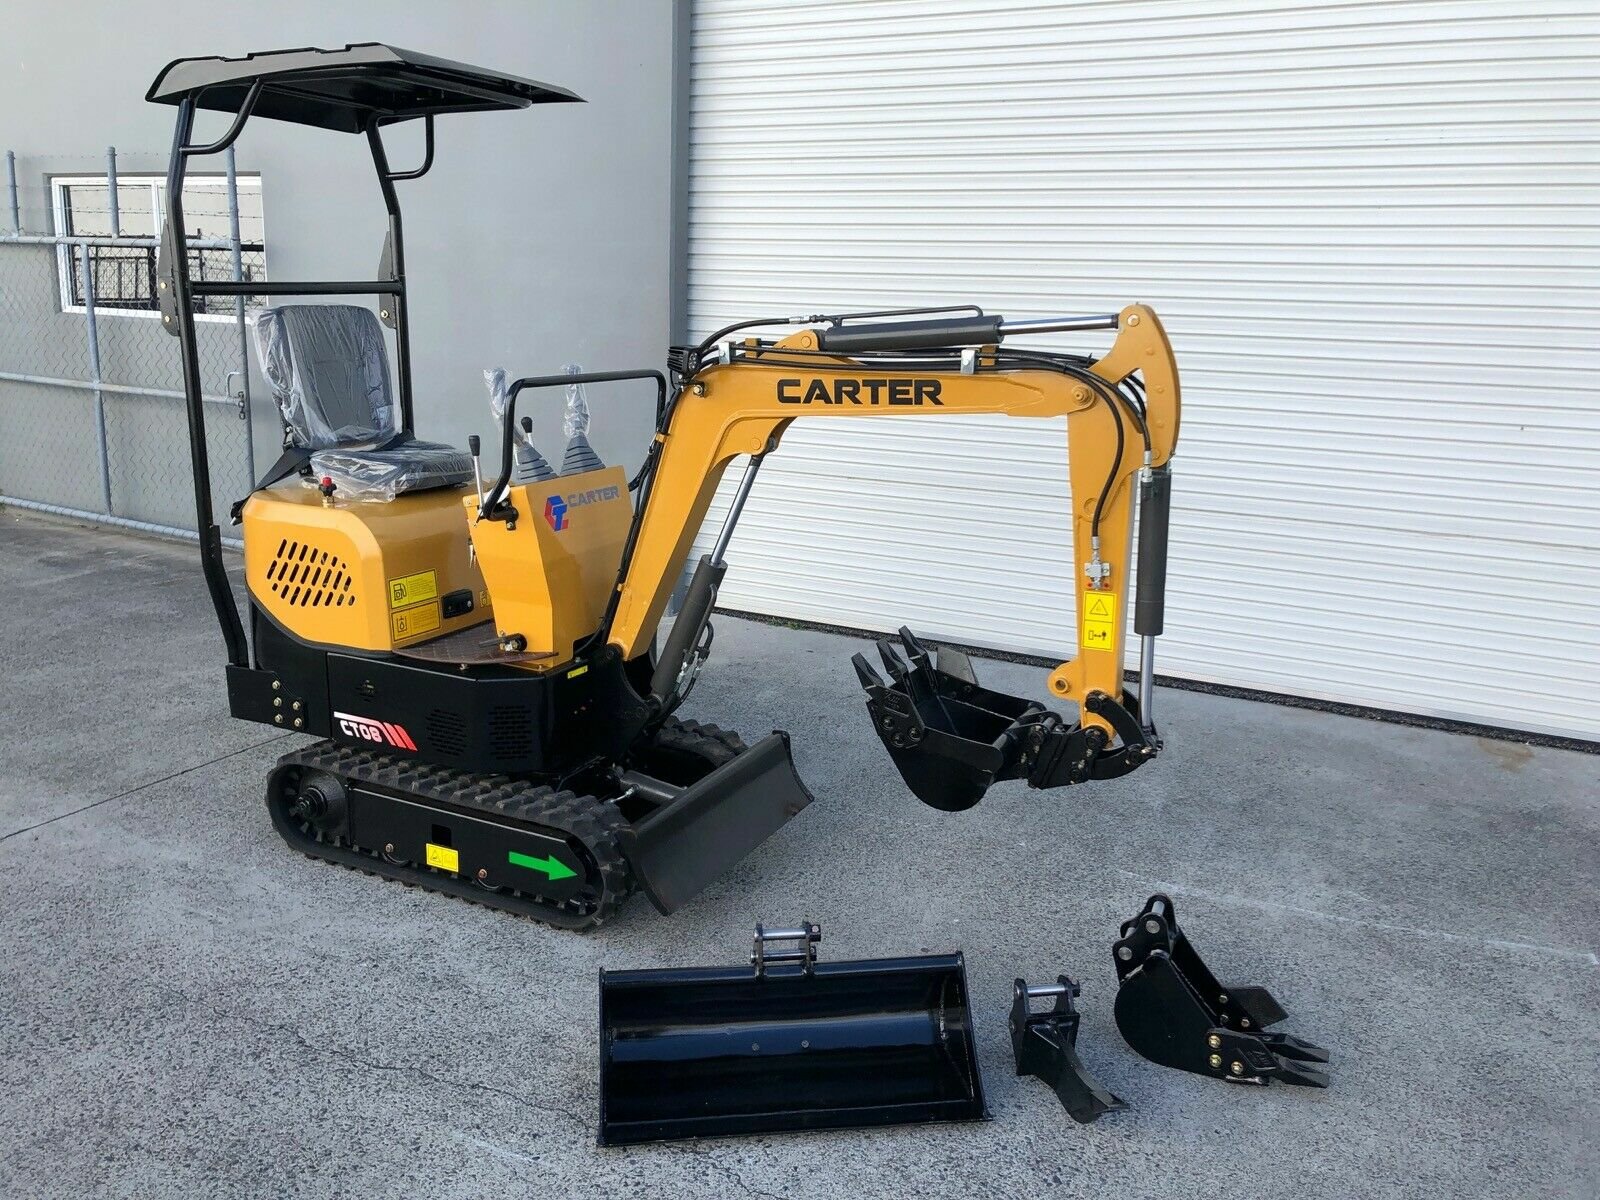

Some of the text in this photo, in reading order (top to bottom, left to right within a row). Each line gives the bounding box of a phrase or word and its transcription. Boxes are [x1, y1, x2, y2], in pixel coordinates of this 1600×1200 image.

[777, 379, 944, 405] CARTER
[567, 485, 619, 508] CARTER
[340, 719, 382, 743] CT08
